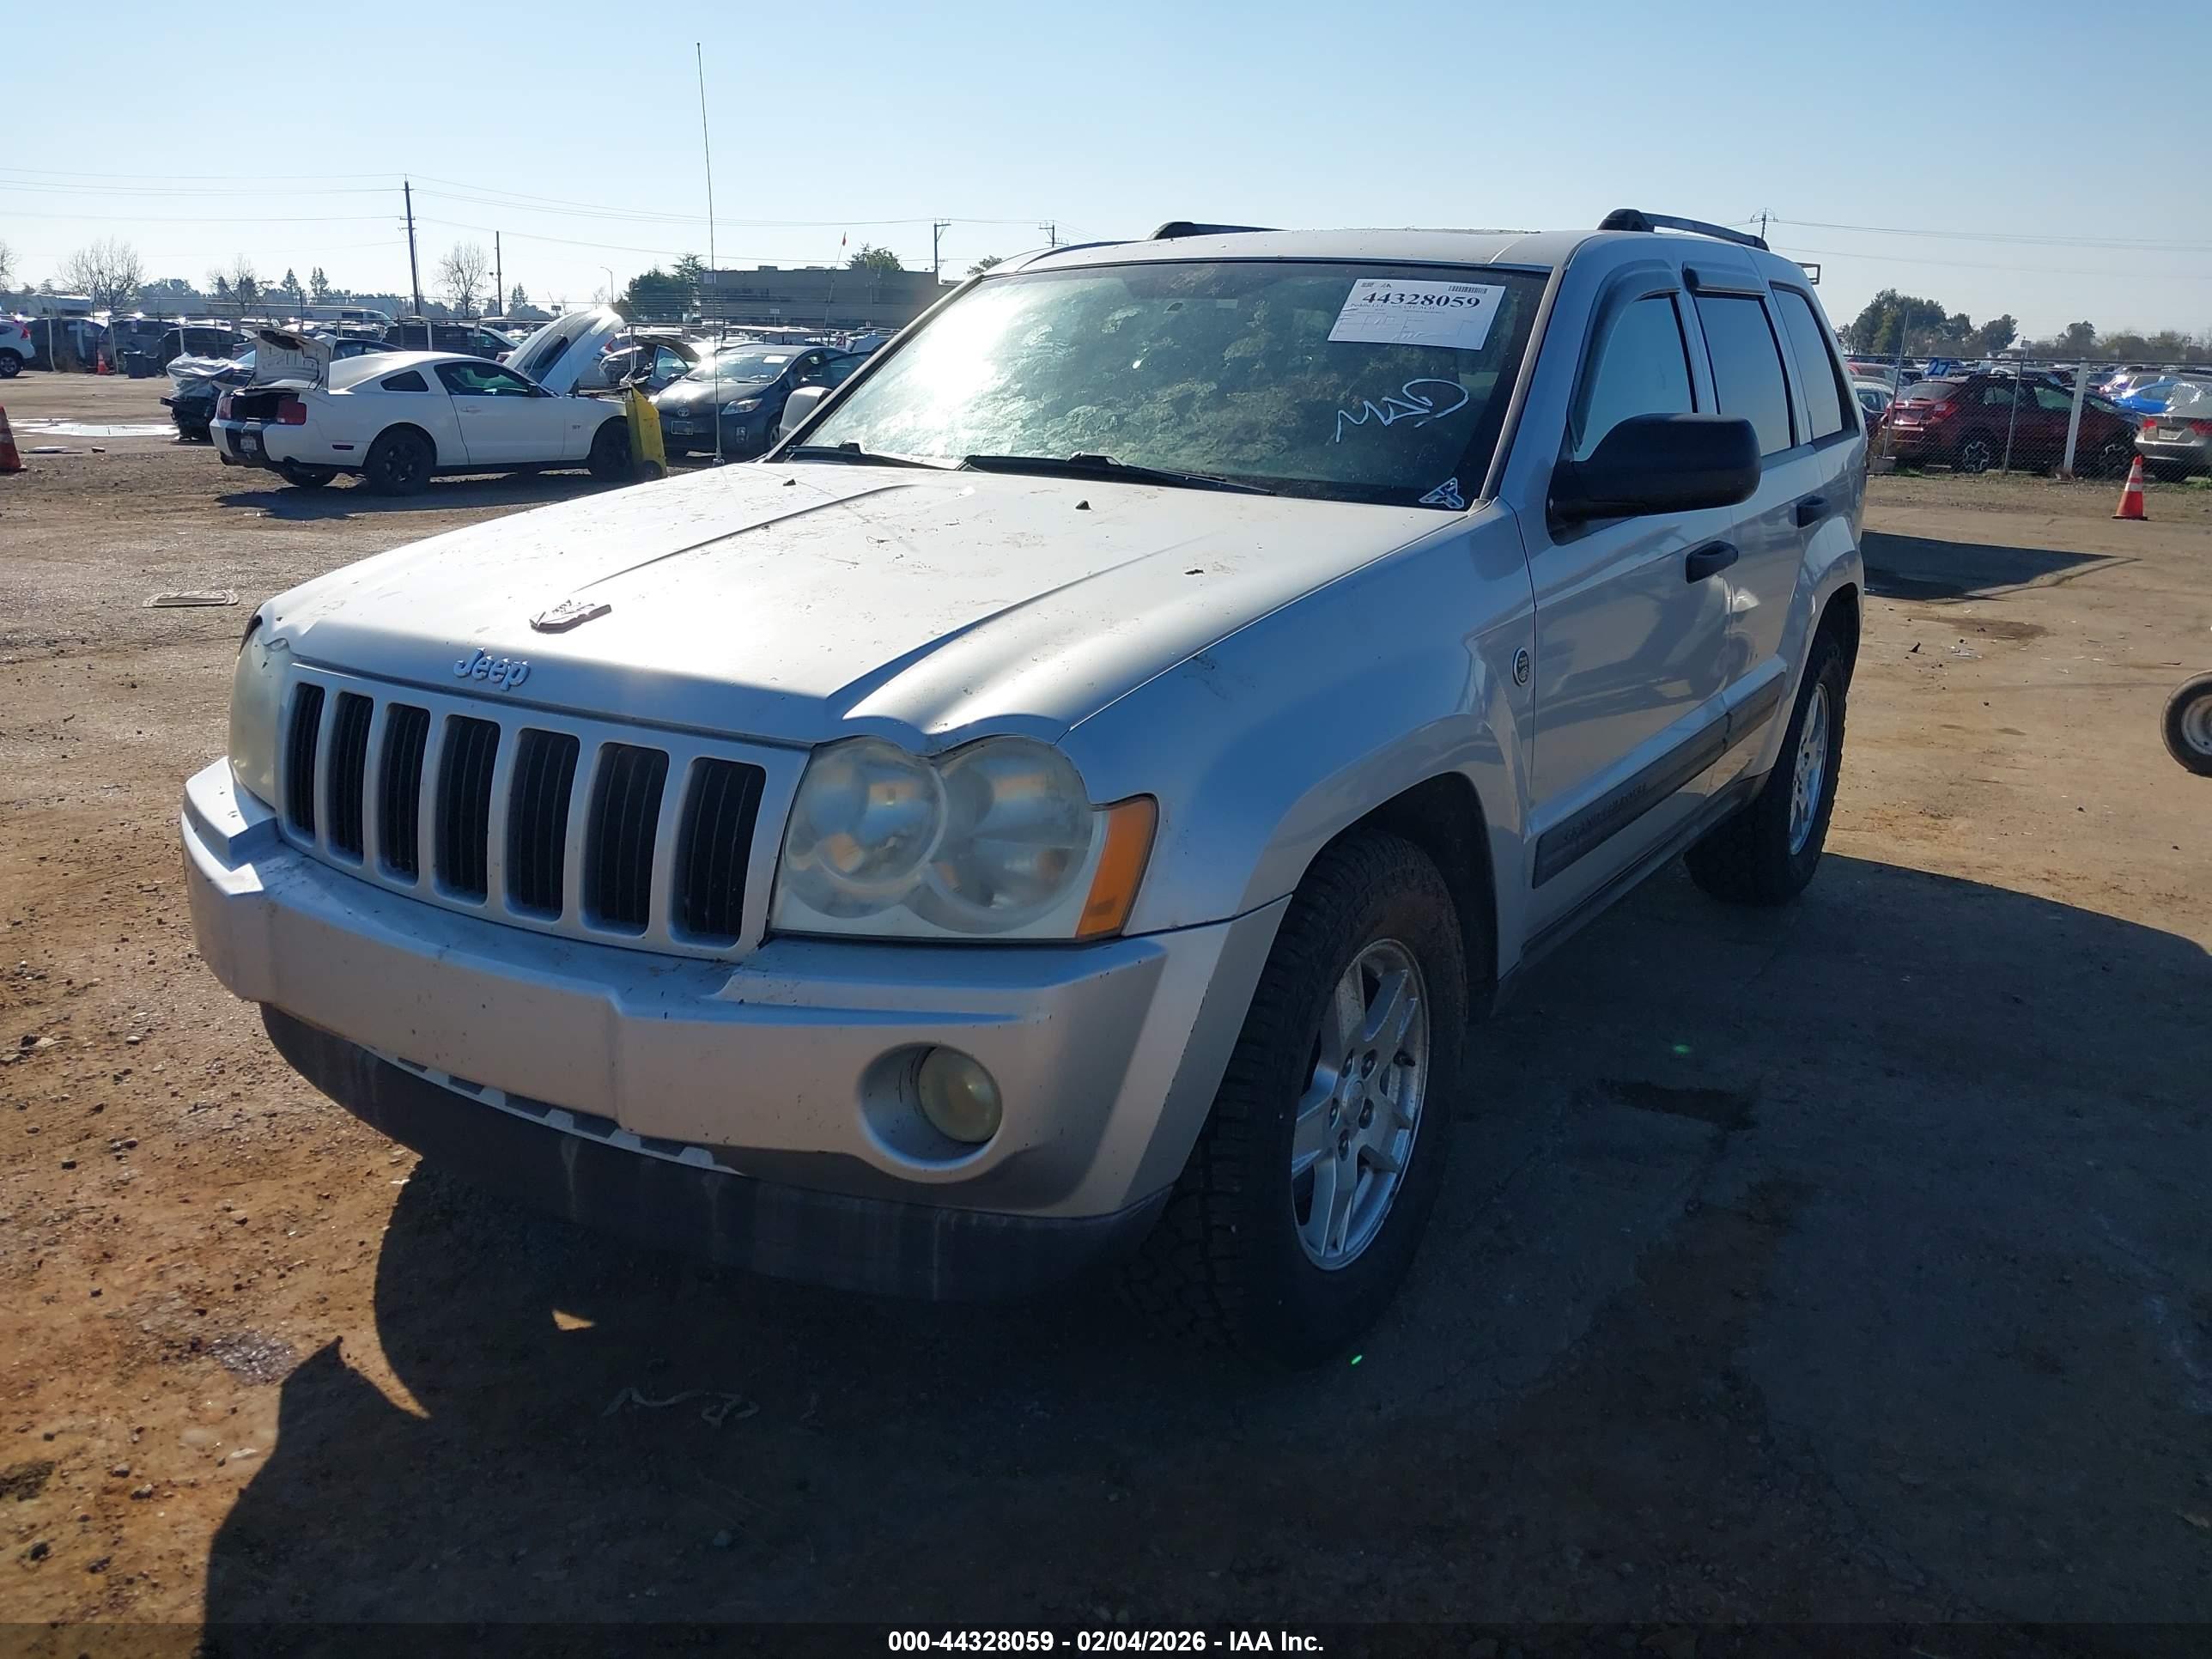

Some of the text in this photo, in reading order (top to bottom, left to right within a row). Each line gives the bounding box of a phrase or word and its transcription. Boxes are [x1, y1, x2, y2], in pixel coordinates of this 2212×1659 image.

[1363, 292, 1480, 308] 44328059
[1928, 357, 1951, 377] 27
[453, 647, 531, 691] Jeep
